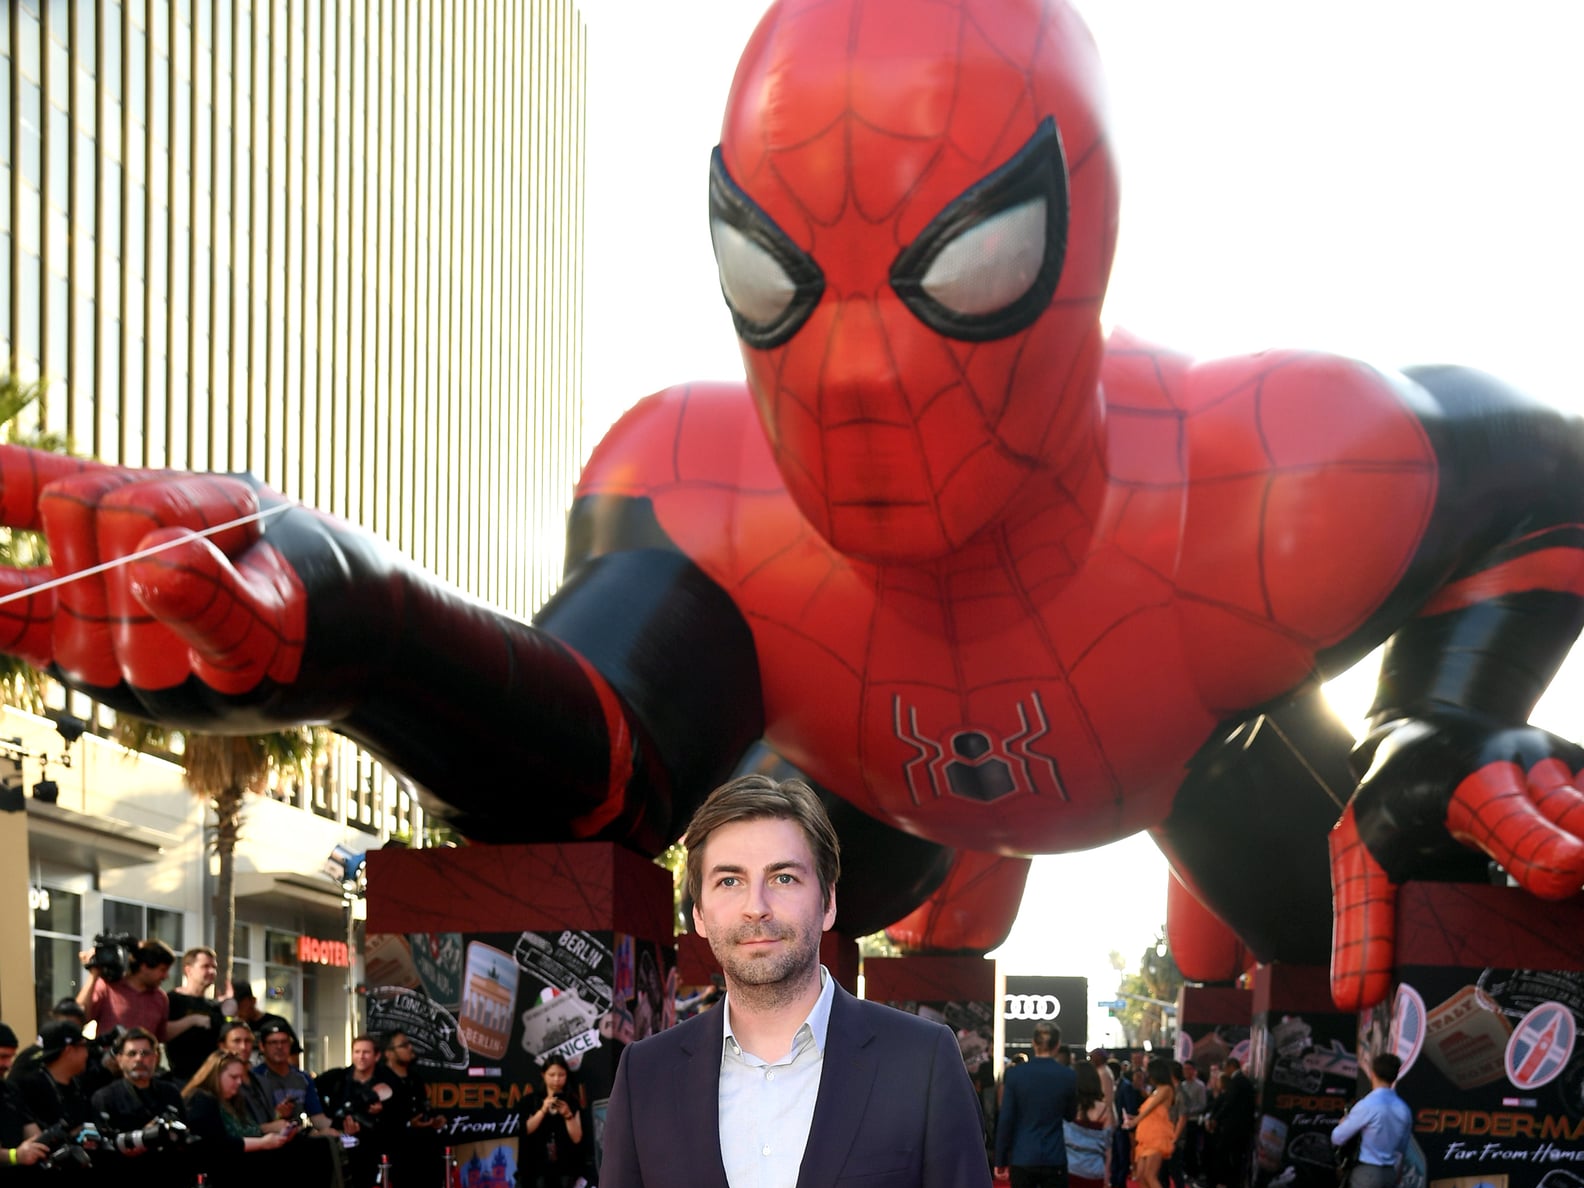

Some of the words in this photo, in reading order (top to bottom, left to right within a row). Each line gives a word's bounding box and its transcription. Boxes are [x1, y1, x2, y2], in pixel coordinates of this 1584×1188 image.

[558, 930, 604, 969] BERLIN
[465, 1027, 501, 1052] BERLIN
[543, 1033, 593, 1062] NICE
[424, 1082, 587, 1109] IDER-M
[450, 1115, 496, 1135] From
[1414, 1108, 1584, 1141] SPIDER-M
[1444, 1142, 1476, 1161] Far
[1478, 1142, 1527, 1162] From
